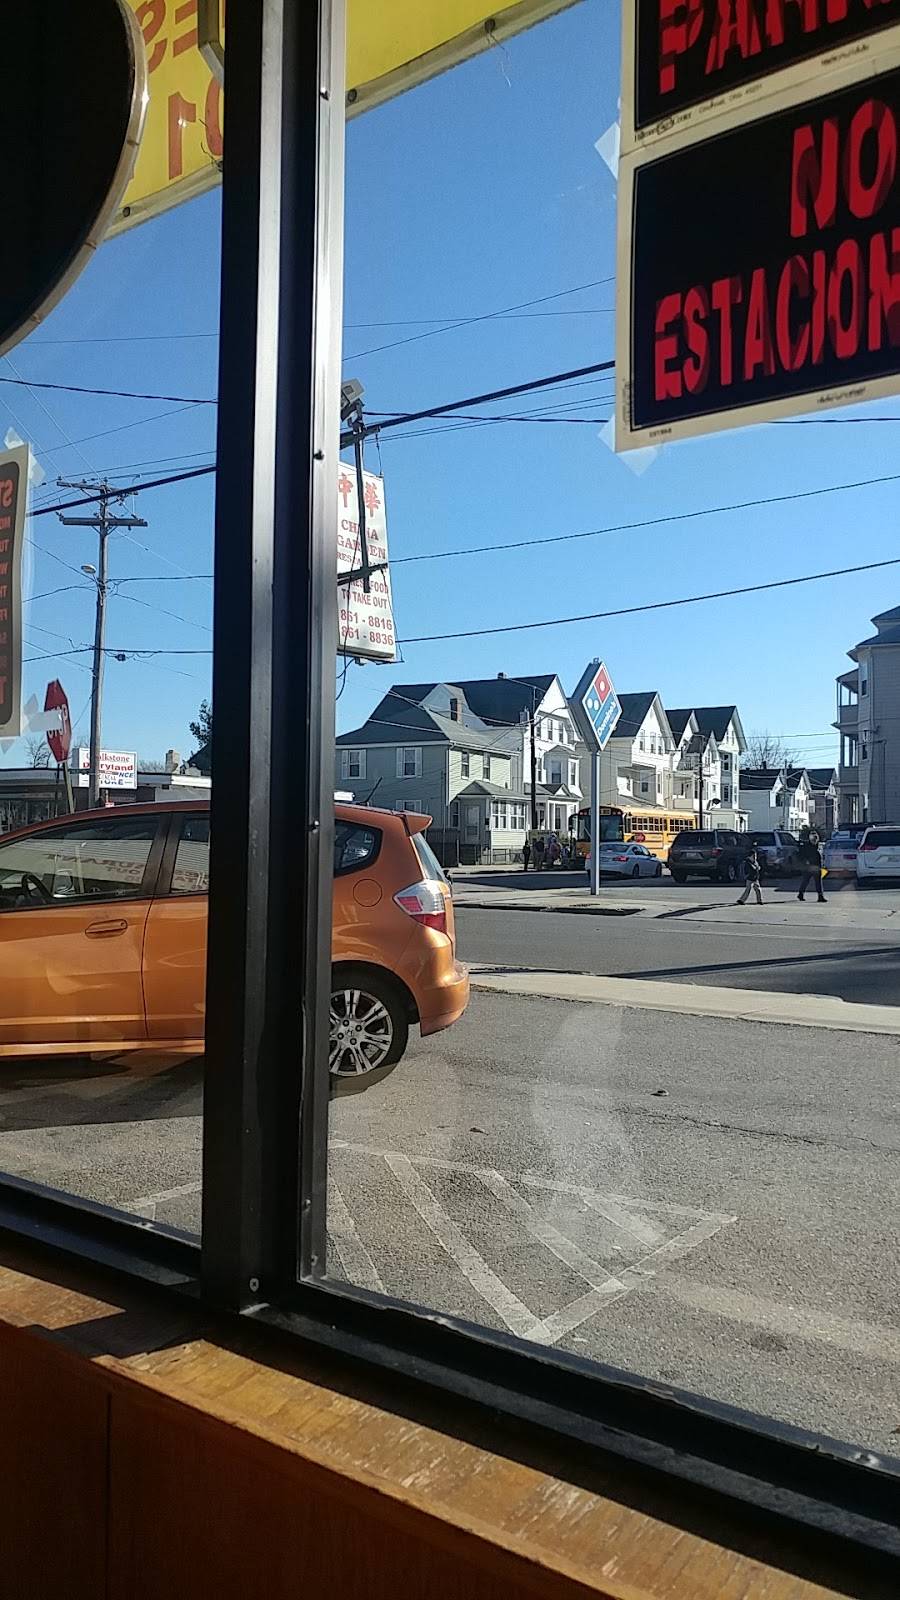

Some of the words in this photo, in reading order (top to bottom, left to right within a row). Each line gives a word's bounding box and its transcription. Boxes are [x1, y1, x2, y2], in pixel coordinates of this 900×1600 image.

[790, 100, 897, 238] NO
[352, 591, 371, 606] TAKE
[373, 597, 387, 609] OUT
[340, 609, 358, 624] 861
[368, 615, 393, 630] 8816
[341, 625, 359, 640] 861
[369, 631, 394, 646] 8836
